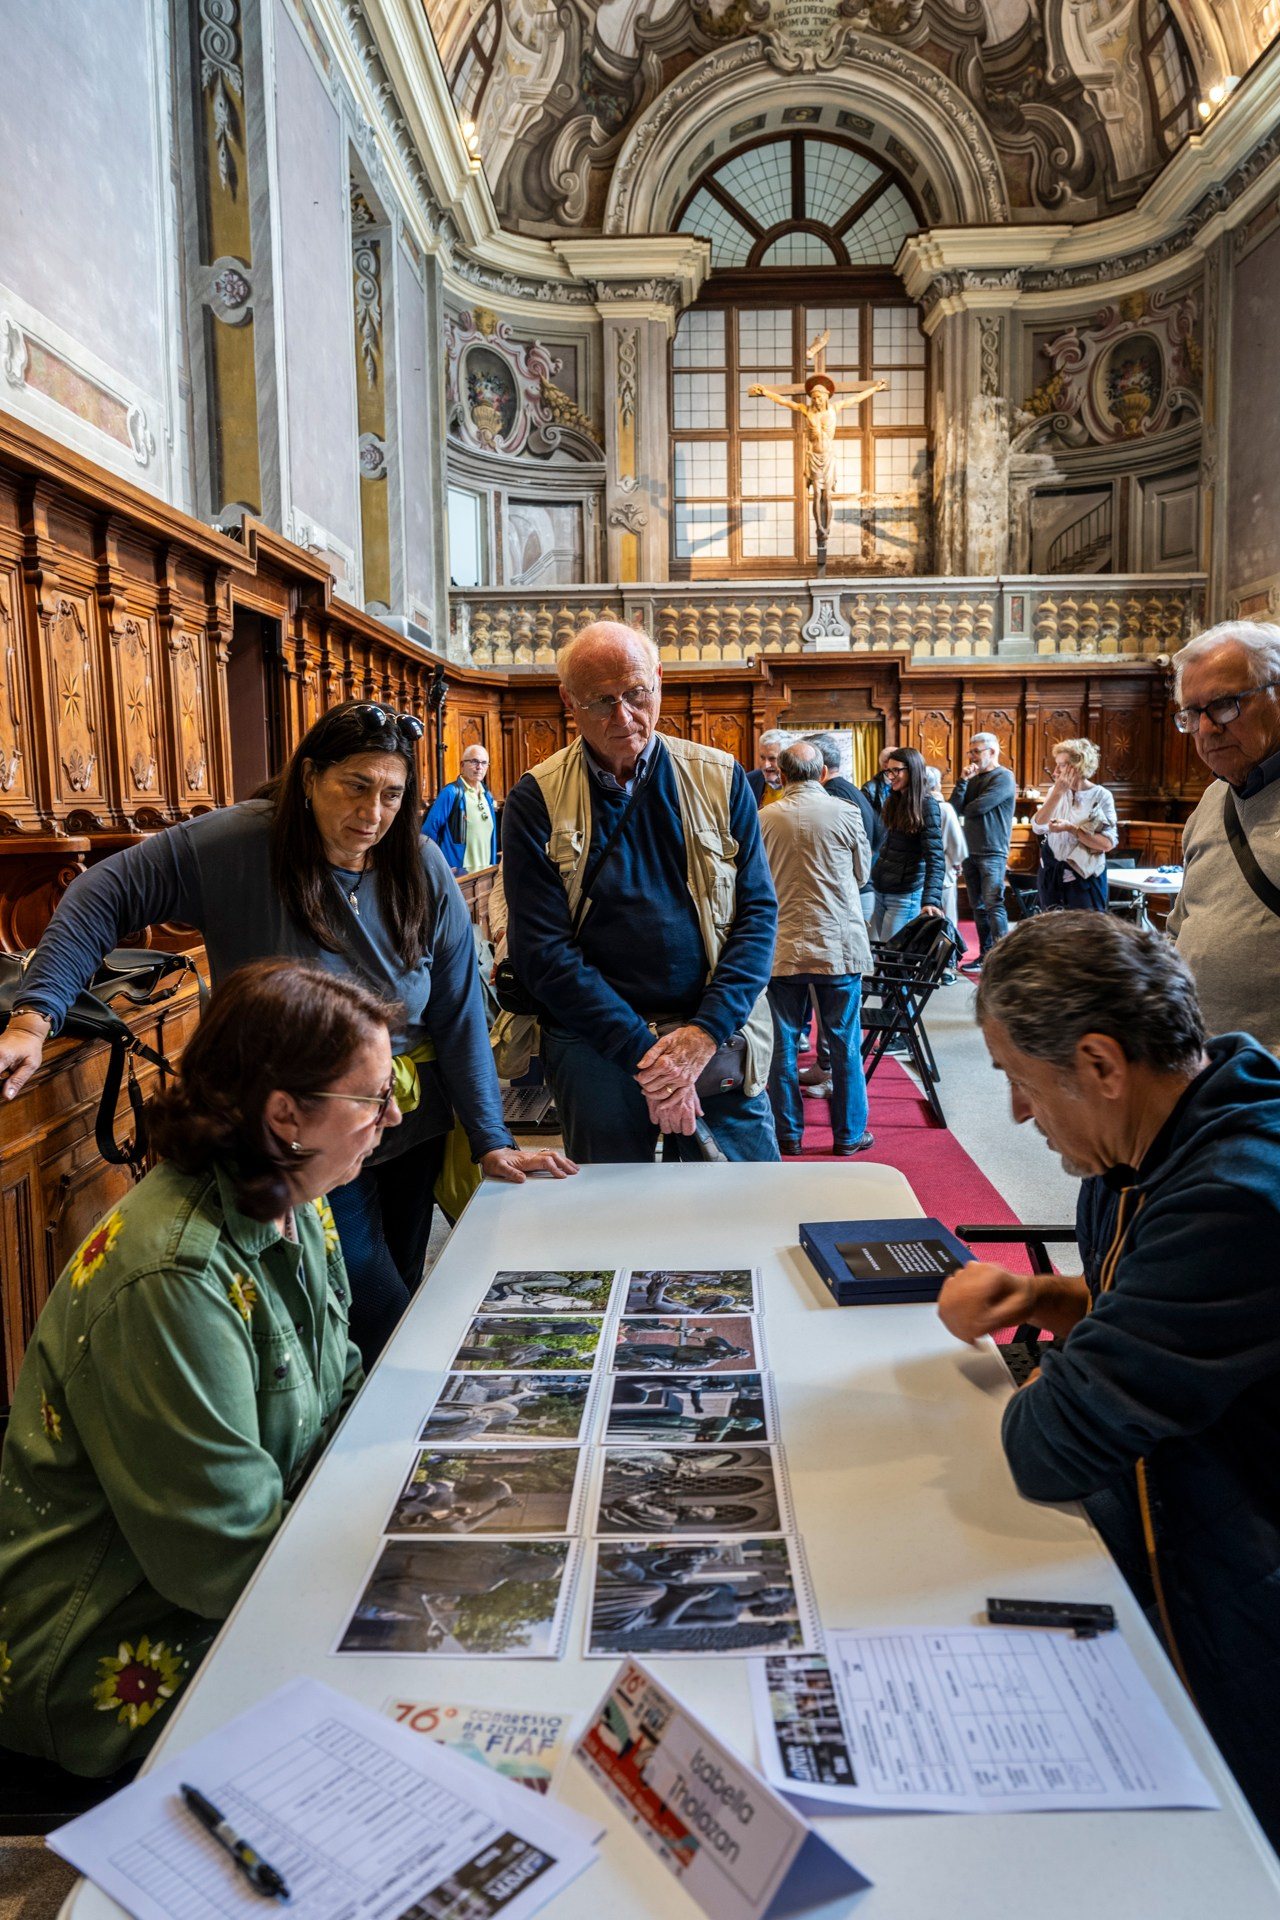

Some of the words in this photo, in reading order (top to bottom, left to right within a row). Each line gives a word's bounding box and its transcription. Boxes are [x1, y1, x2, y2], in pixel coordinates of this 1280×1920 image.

[774, 6, 802, 20] DILEXI
[470, 1710, 562, 1728] CONGRESSO
[462, 1721, 560, 1739] NAZIONALE
[484, 1734, 556, 1757] FIAF
[690, 1747, 755, 1826] Isabella
[669, 1773, 741, 1865] Tholazan
